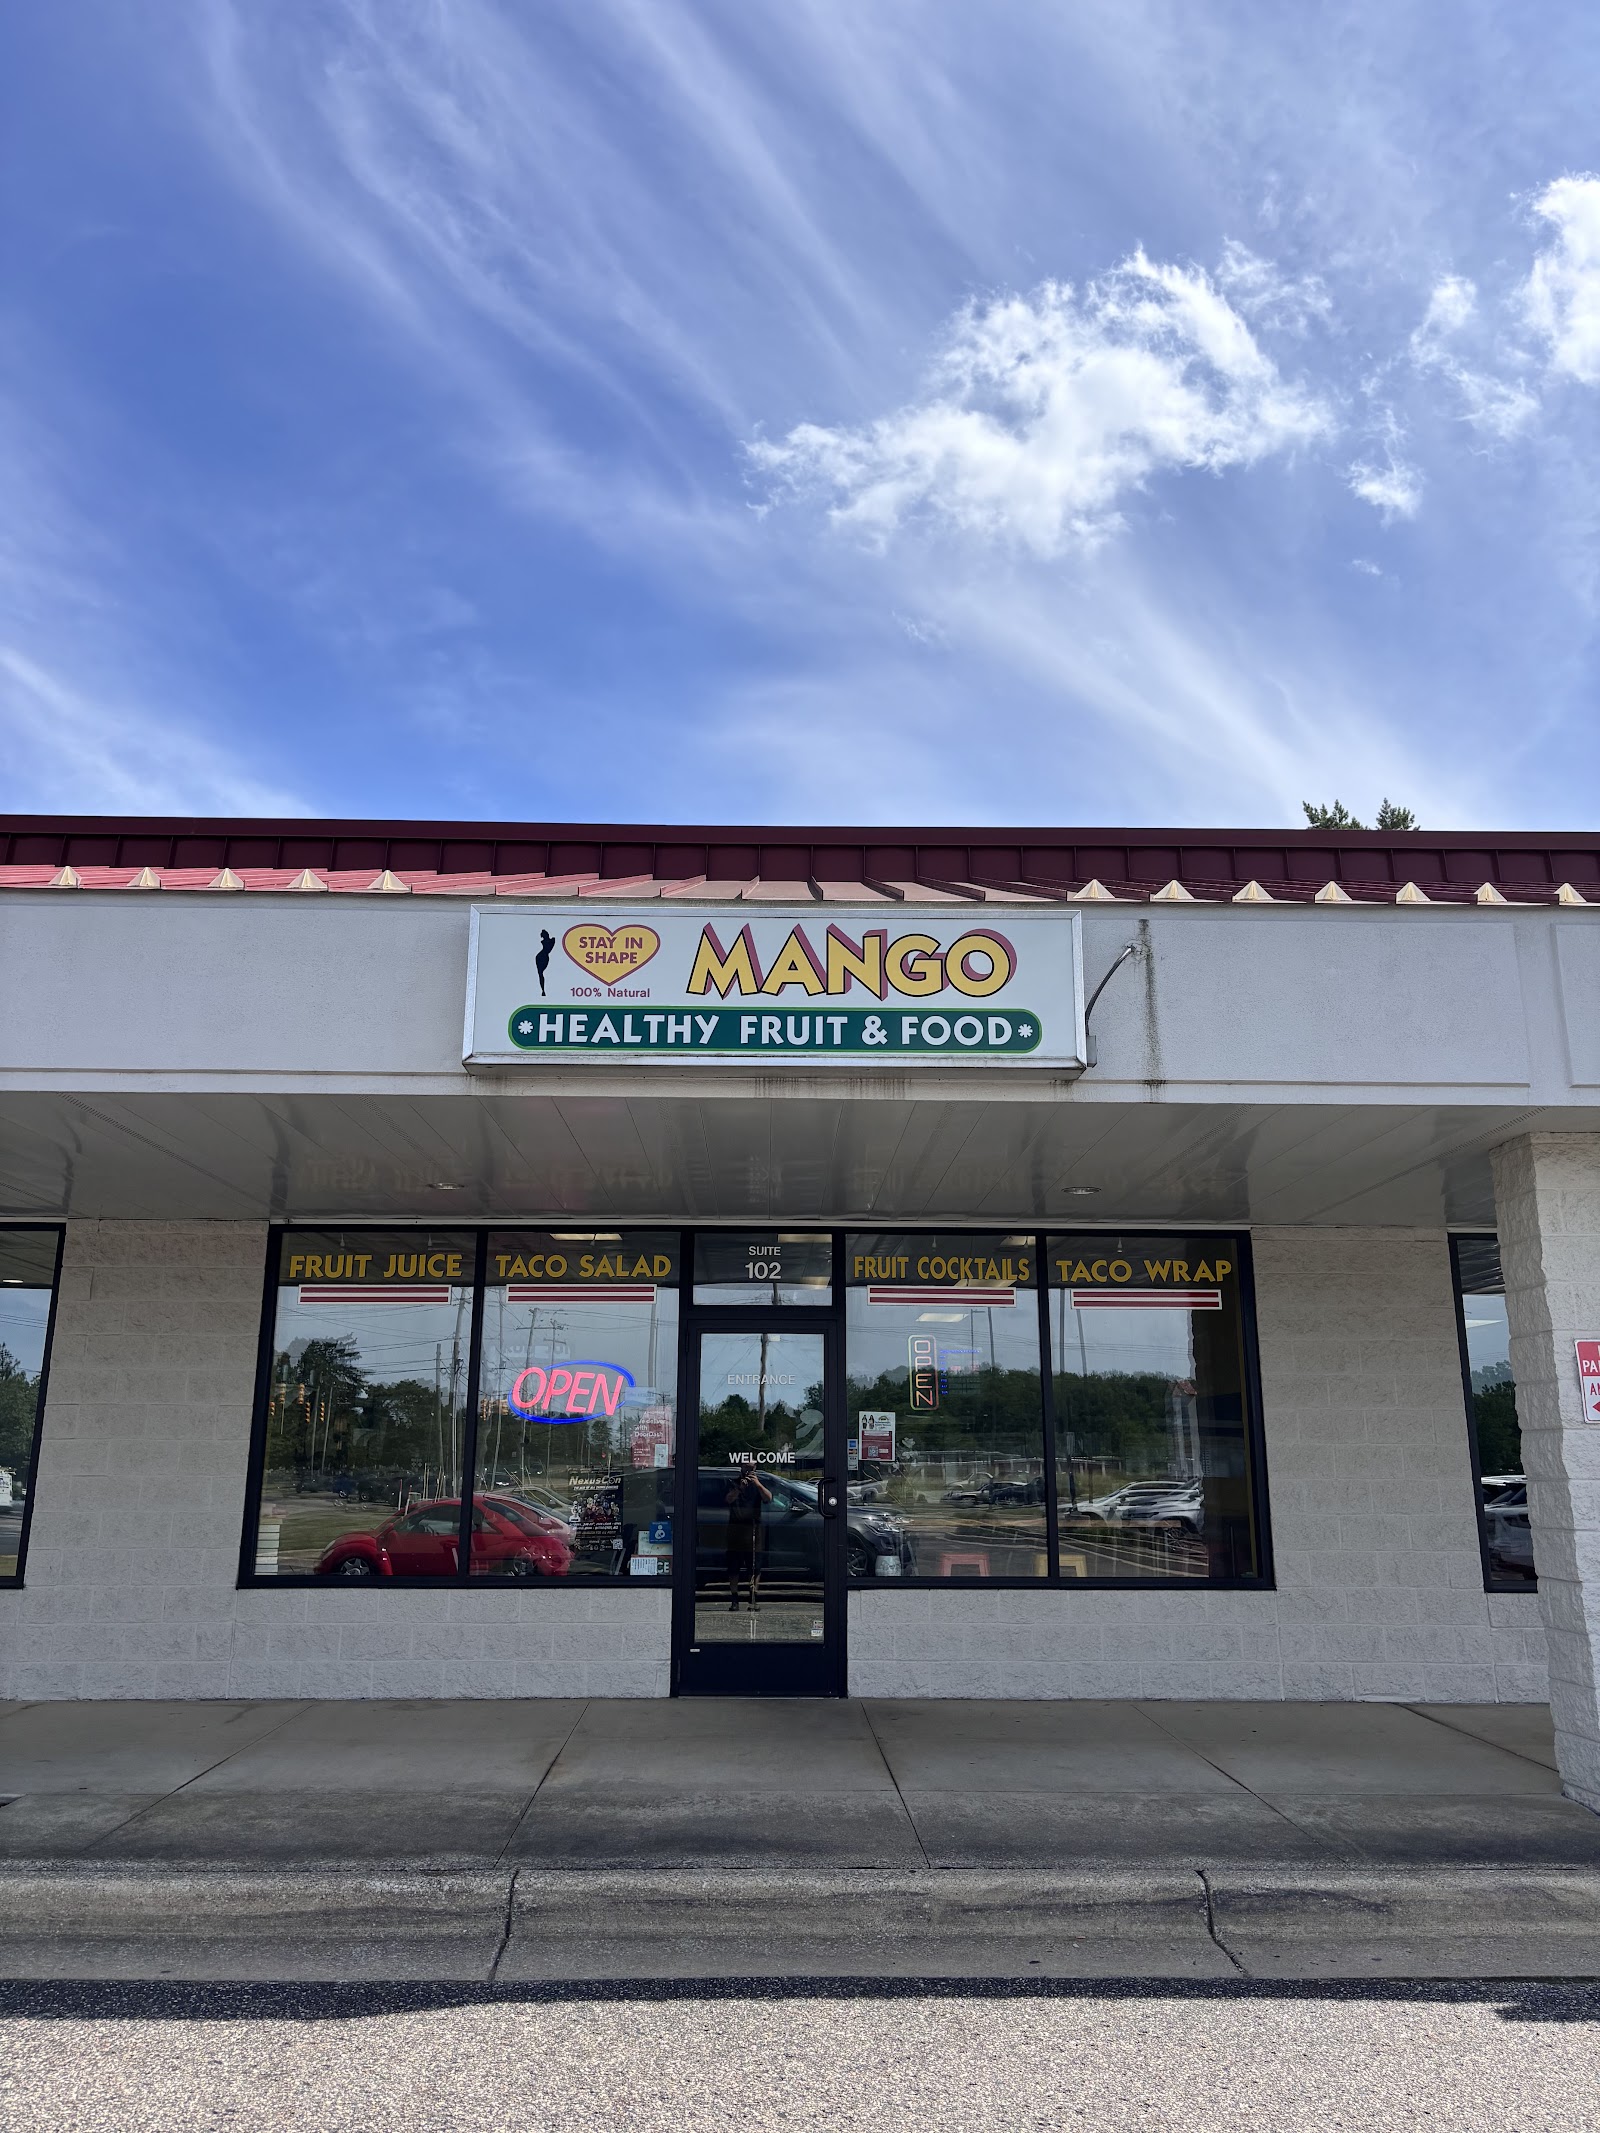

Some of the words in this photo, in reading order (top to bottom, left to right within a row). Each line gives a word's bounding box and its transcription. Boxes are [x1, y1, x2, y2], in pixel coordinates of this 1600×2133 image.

[579, 937, 617, 949] STAY
[625, 937, 643, 949] IN
[585, 952, 638, 964] SHAPE
[686, 922, 1017, 1001] MANGO
[570, 987, 602, 998] 100%
[607, 988, 650, 998] Natural
[538, 1013, 720, 1045] HEALTHY
[740, 1015, 849, 1046] FRUIT
[861, 1016, 888, 1046] &
[901, 1015, 1014, 1046] FOOD
[749, 1246, 781, 1256] SUITE
[289, 1254, 374, 1278] FRUIT
[383, 1254, 462, 1278] JUICE
[495, 1254, 568, 1278] TACO
[579, 1254, 672, 1278] SALAD
[745, 1262, 782, 1279] 102
[854, 1256, 910, 1279] FRUIT
[917, 1256, 1030, 1281] COCKTAILS
[1056, 1260, 1132, 1283] TACO
[1144, 1260, 1232, 1283] WRAP
[727, 1375, 796, 1385] ENTRANCE
[914, 1340, 933, 1407] OPEN
[512, 1367, 624, 1416] OPEN
[729, 1452, 796, 1464] WELCOME
[568, 1475, 622, 1486] NexusCon
